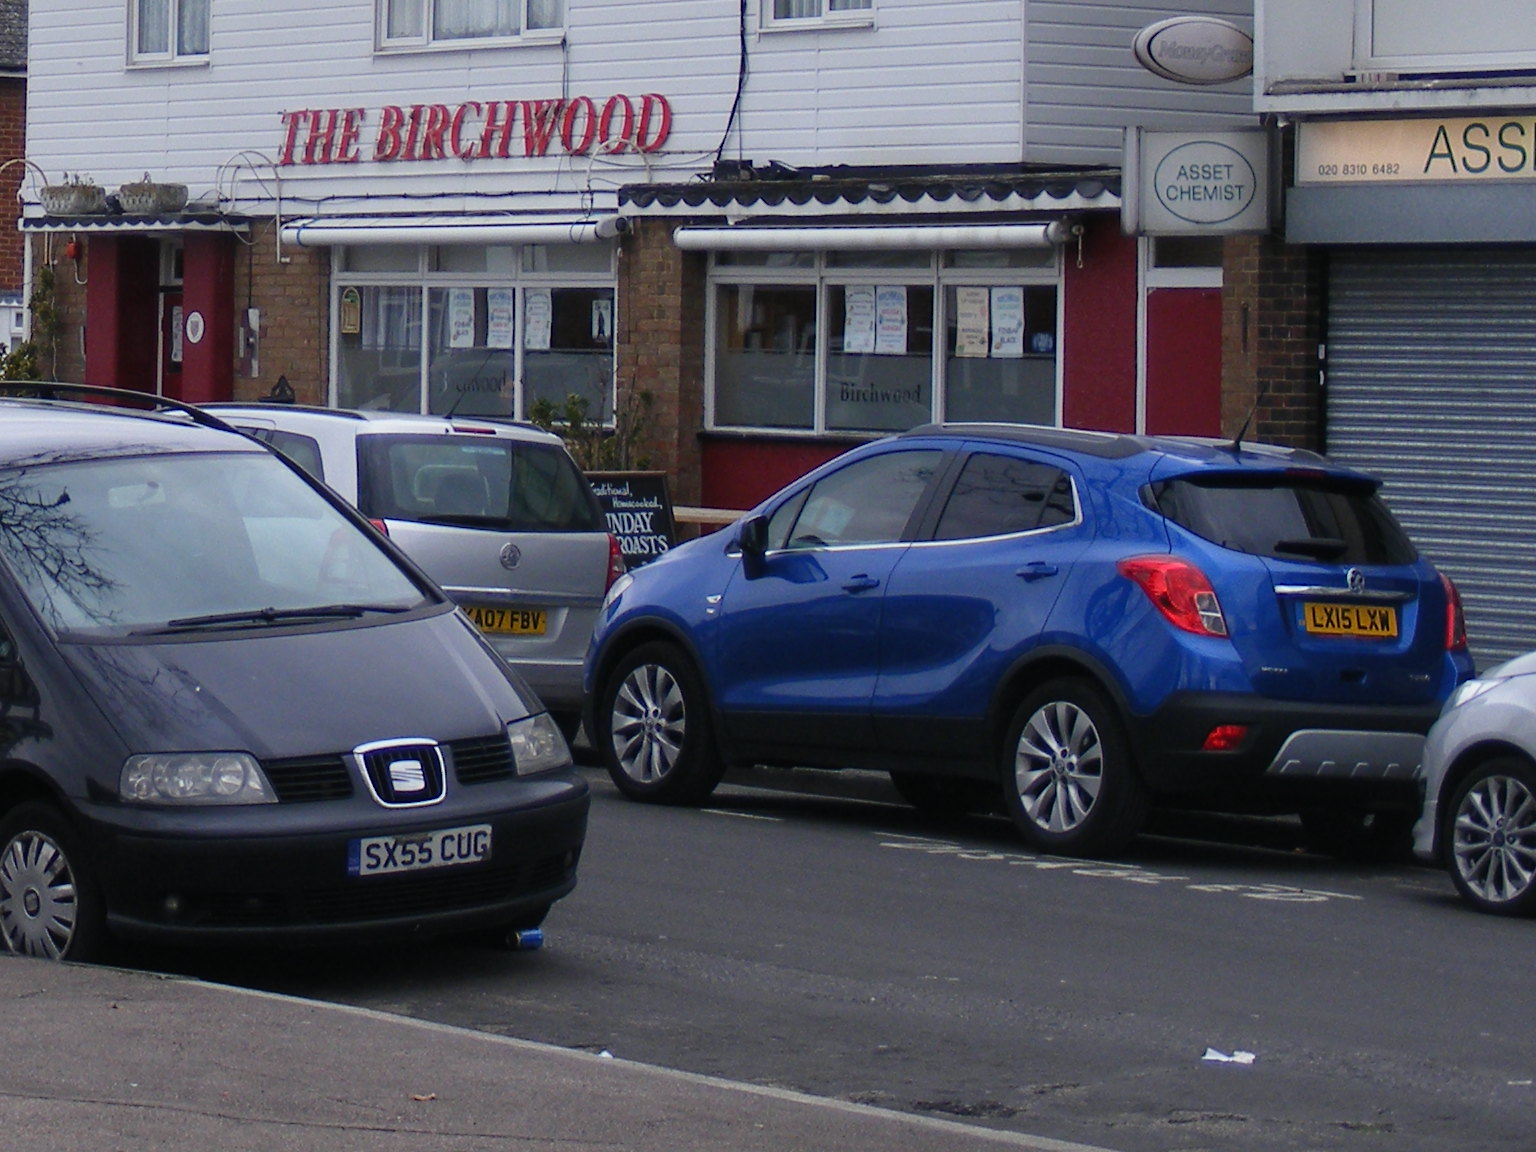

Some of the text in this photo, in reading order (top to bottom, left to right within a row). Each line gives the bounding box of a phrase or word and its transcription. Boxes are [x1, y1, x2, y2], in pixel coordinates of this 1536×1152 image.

[280, 93, 672, 166] THE BIRCHWOOD
[1423, 121, 1536, 174] ASS
[1176, 163, 1235, 181] ASSET
[1318, 163, 1401, 176] 020 8310 6482
[1165, 184, 1246, 202] CHEMIST
[840, 381, 922, 403] Birchwood
[1312, 605, 1390, 631] LX15 LXW
[366, 830, 489, 870] SX55 CUG
